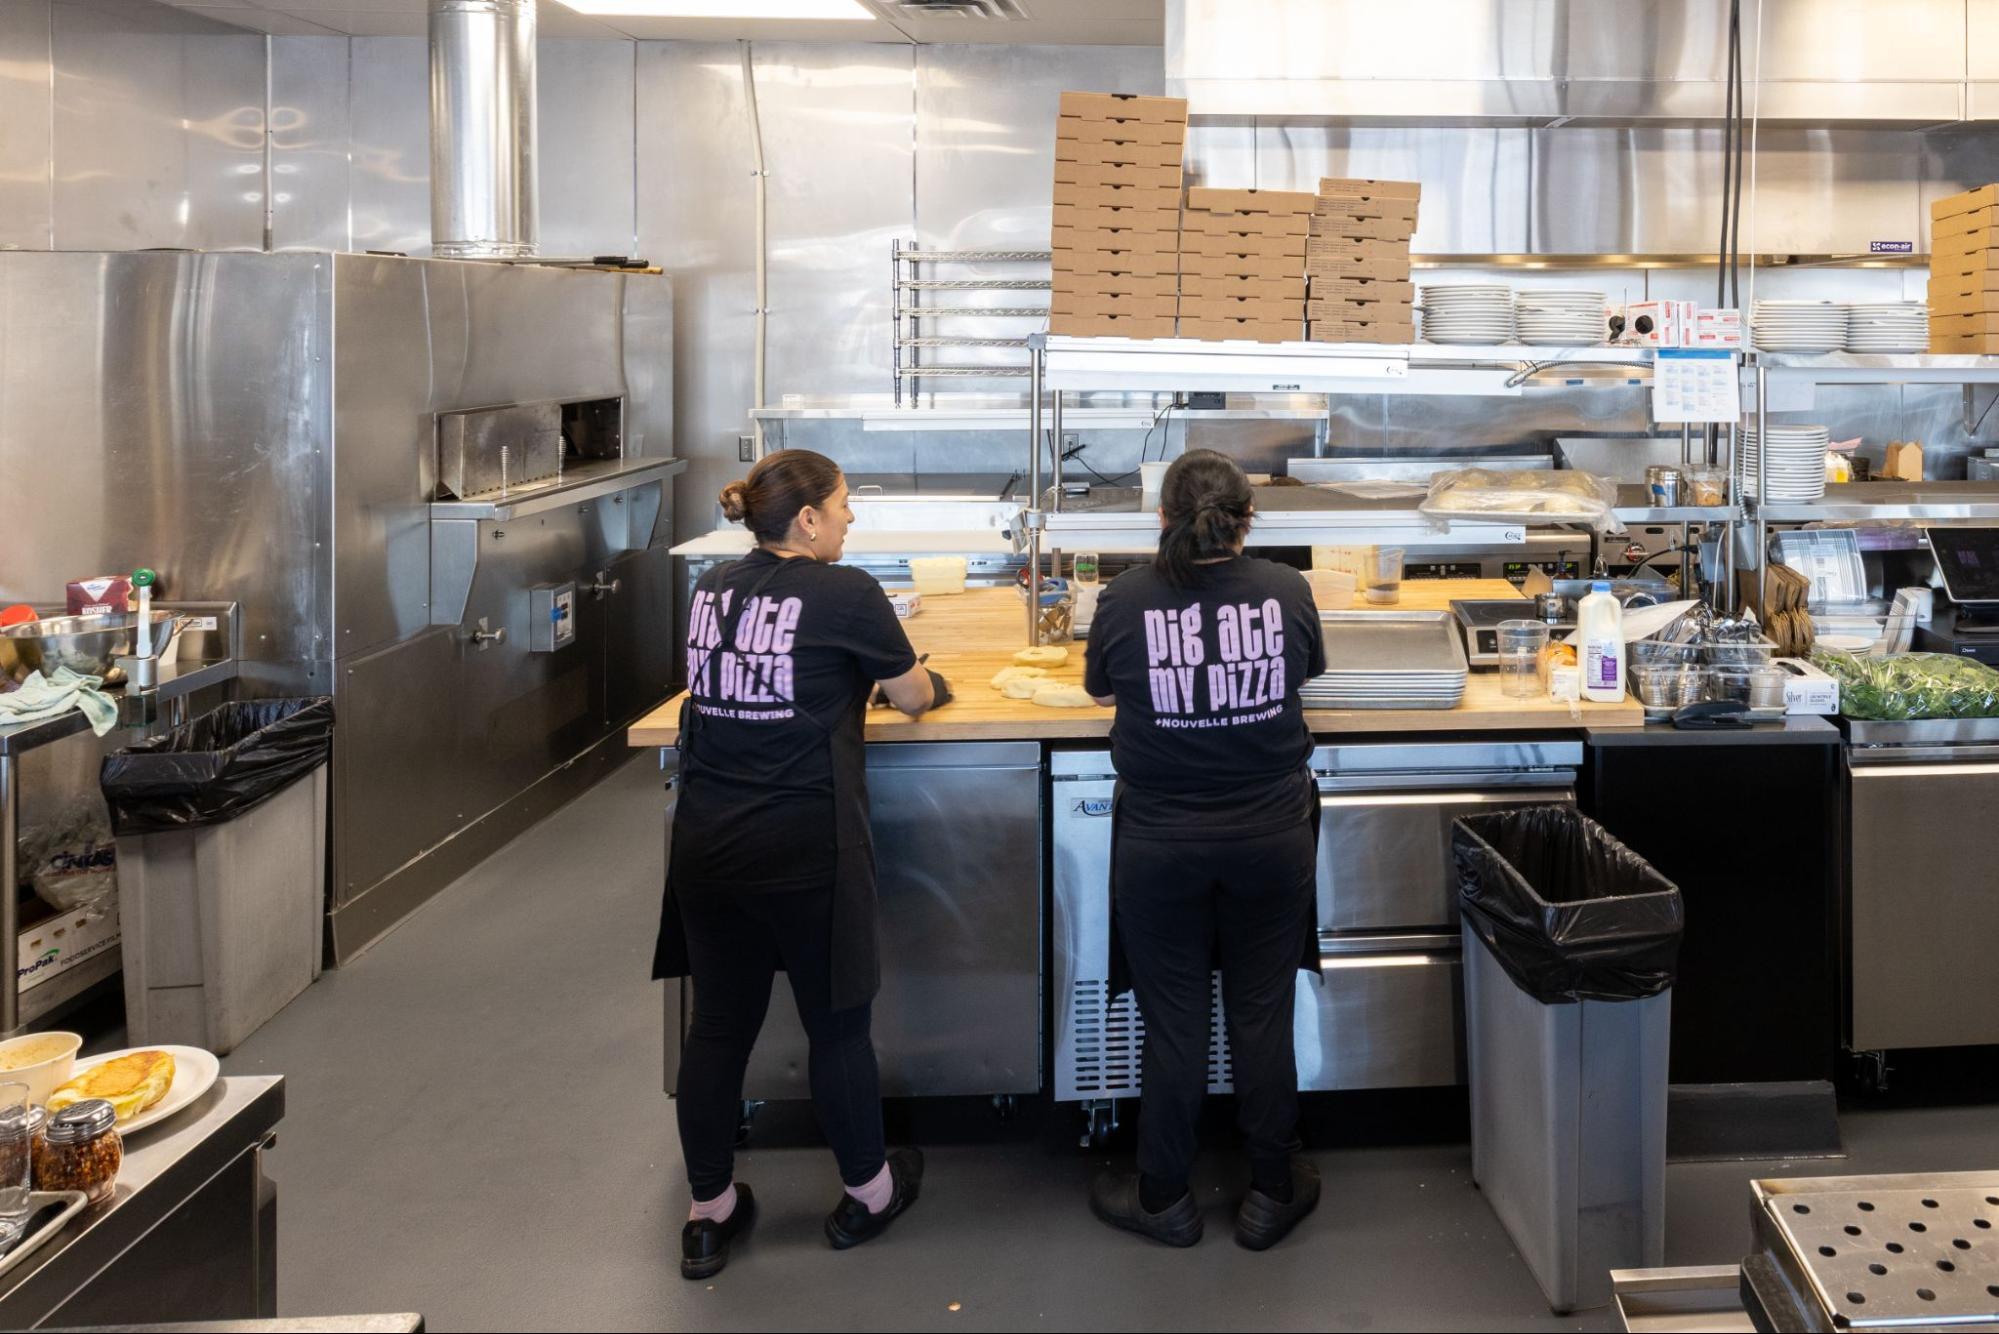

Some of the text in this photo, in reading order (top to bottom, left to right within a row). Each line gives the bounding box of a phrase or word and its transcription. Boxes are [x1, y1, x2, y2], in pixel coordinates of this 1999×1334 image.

[735, 597, 803, 655] ate
[1144, 598, 1285, 667] pig ate
[720, 651, 795, 703] pizza
[1149, 656, 1286, 714] my pizza
[738, 709, 795, 720] BREWING
[1232, 704, 1284, 726] BREWING
[16, 955, 54, 979] ProPak
